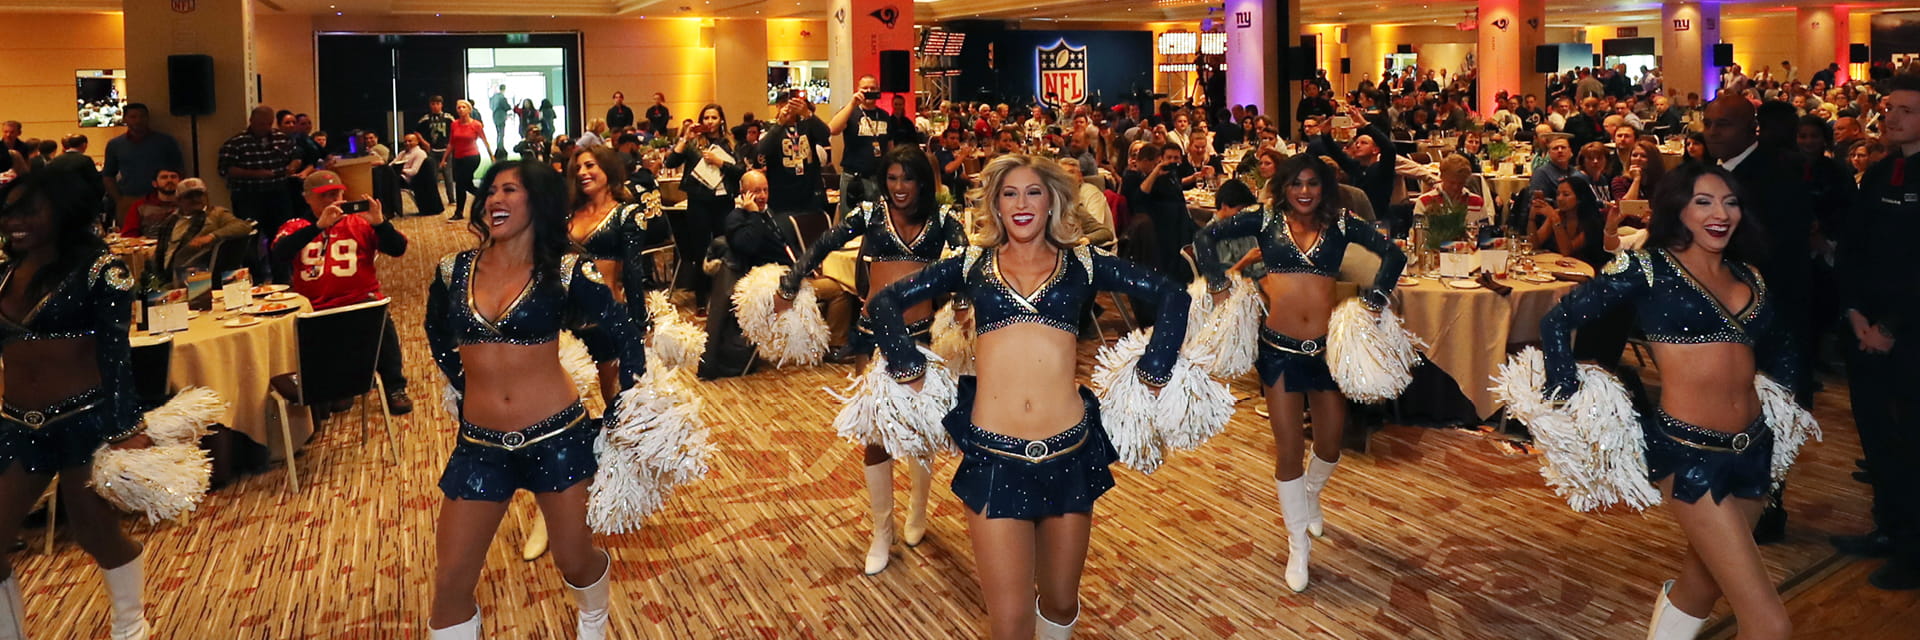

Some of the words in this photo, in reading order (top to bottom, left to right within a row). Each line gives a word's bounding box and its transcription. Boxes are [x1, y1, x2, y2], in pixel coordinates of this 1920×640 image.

[1236, 11, 1251, 28] ny
[1674, 19, 1690, 31] ny
[1044, 73, 1082, 103] NFL
[300, 238, 358, 281] 99
